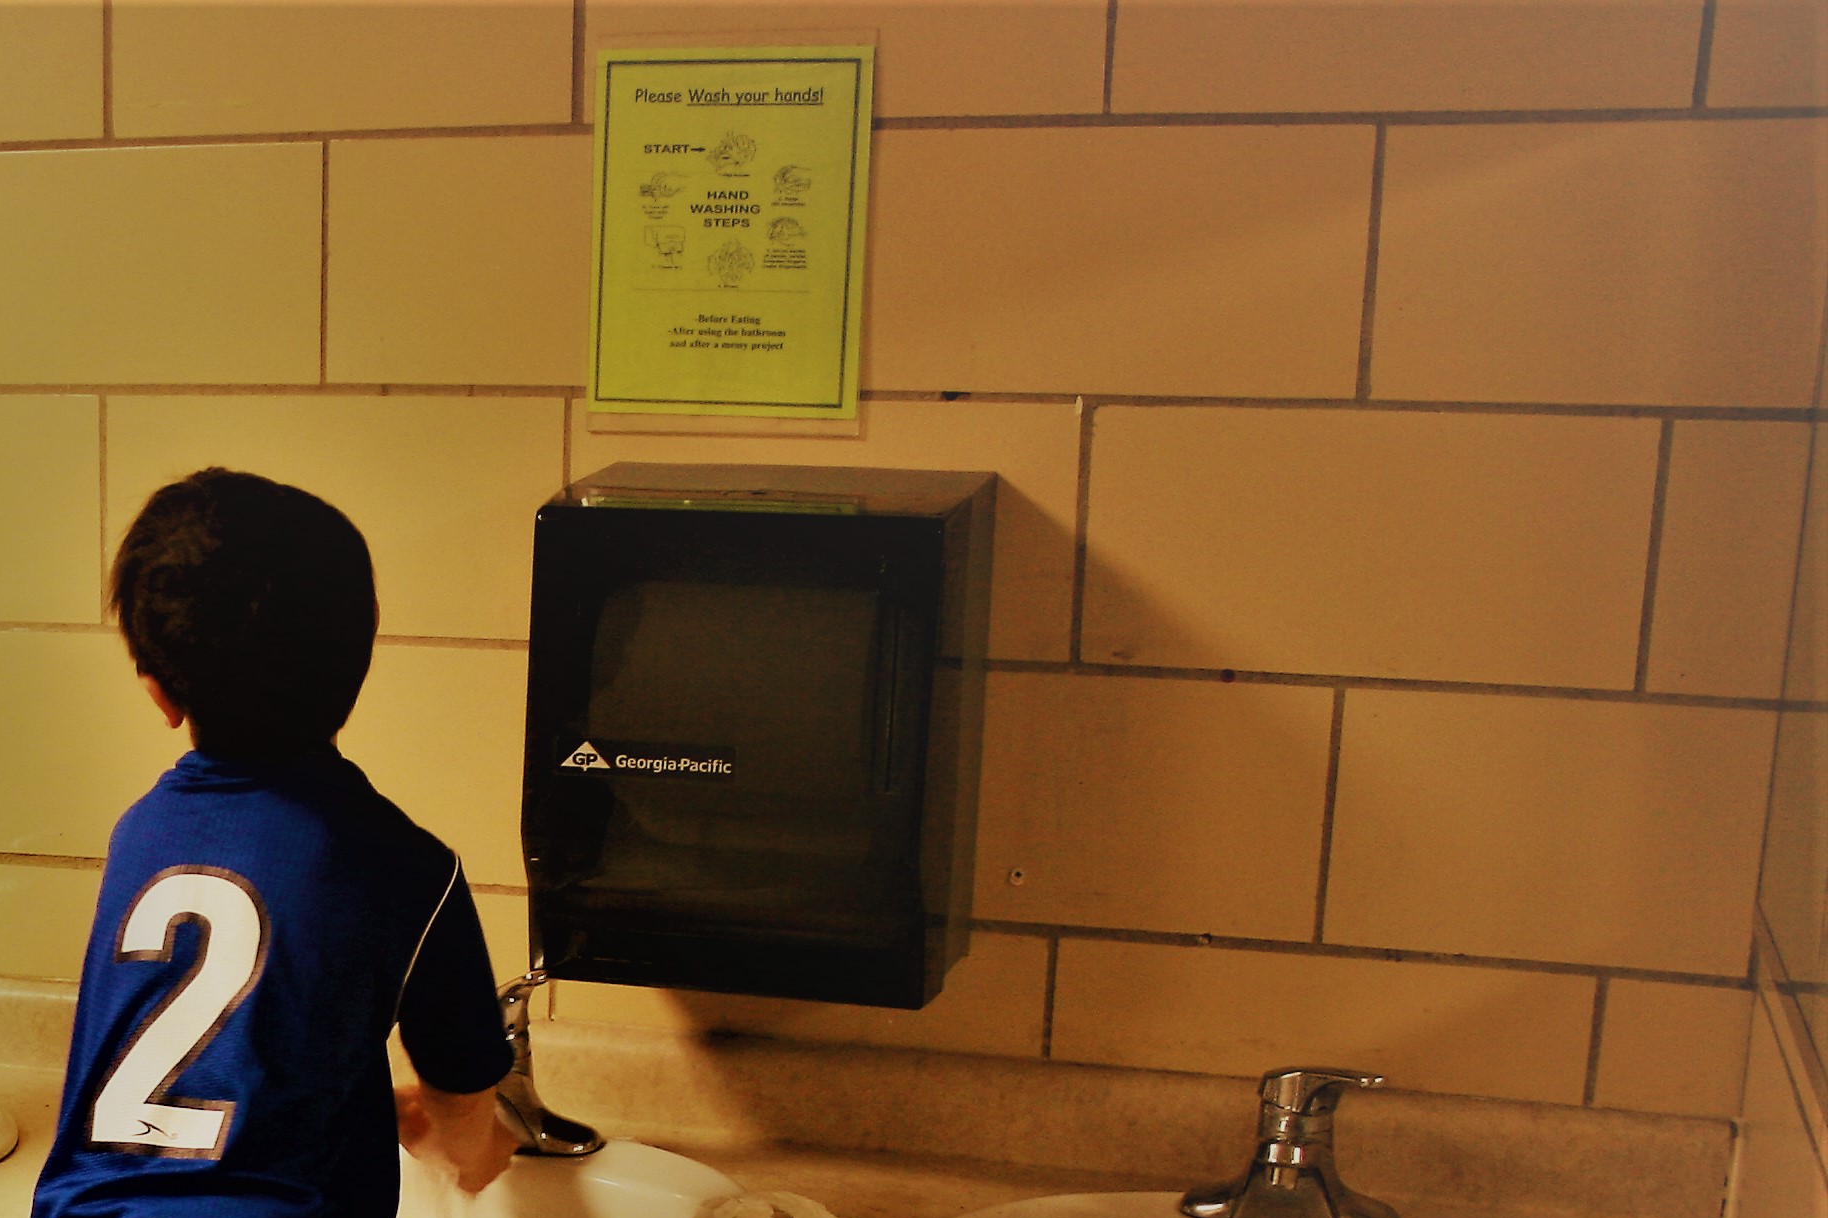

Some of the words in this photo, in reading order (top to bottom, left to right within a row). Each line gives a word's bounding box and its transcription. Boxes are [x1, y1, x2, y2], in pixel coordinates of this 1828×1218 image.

[634, 88, 682, 103] Please
[688, 88, 730, 103] Wash
[736, 89, 769, 105] your
[774, 87, 824, 103] hands!
[643, 144, 690, 155] START
[707, 190, 749, 200] HAND
[690, 204, 761, 214] WASHING
[703, 218, 750, 228] STEPS
[732, 315, 760, 325] Eating
[699, 328, 721, 337] using
[725, 328, 738, 336] the
[741, 328, 786, 337] bathroom
[670, 340, 687, 348] and
[690, 340, 710, 348] after
[752, 341, 784, 351] project
[572, 752, 598, 766] GP
[615, 754, 732, 774] Georgia-Pacific
[87, 866, 269, 1159] 2
